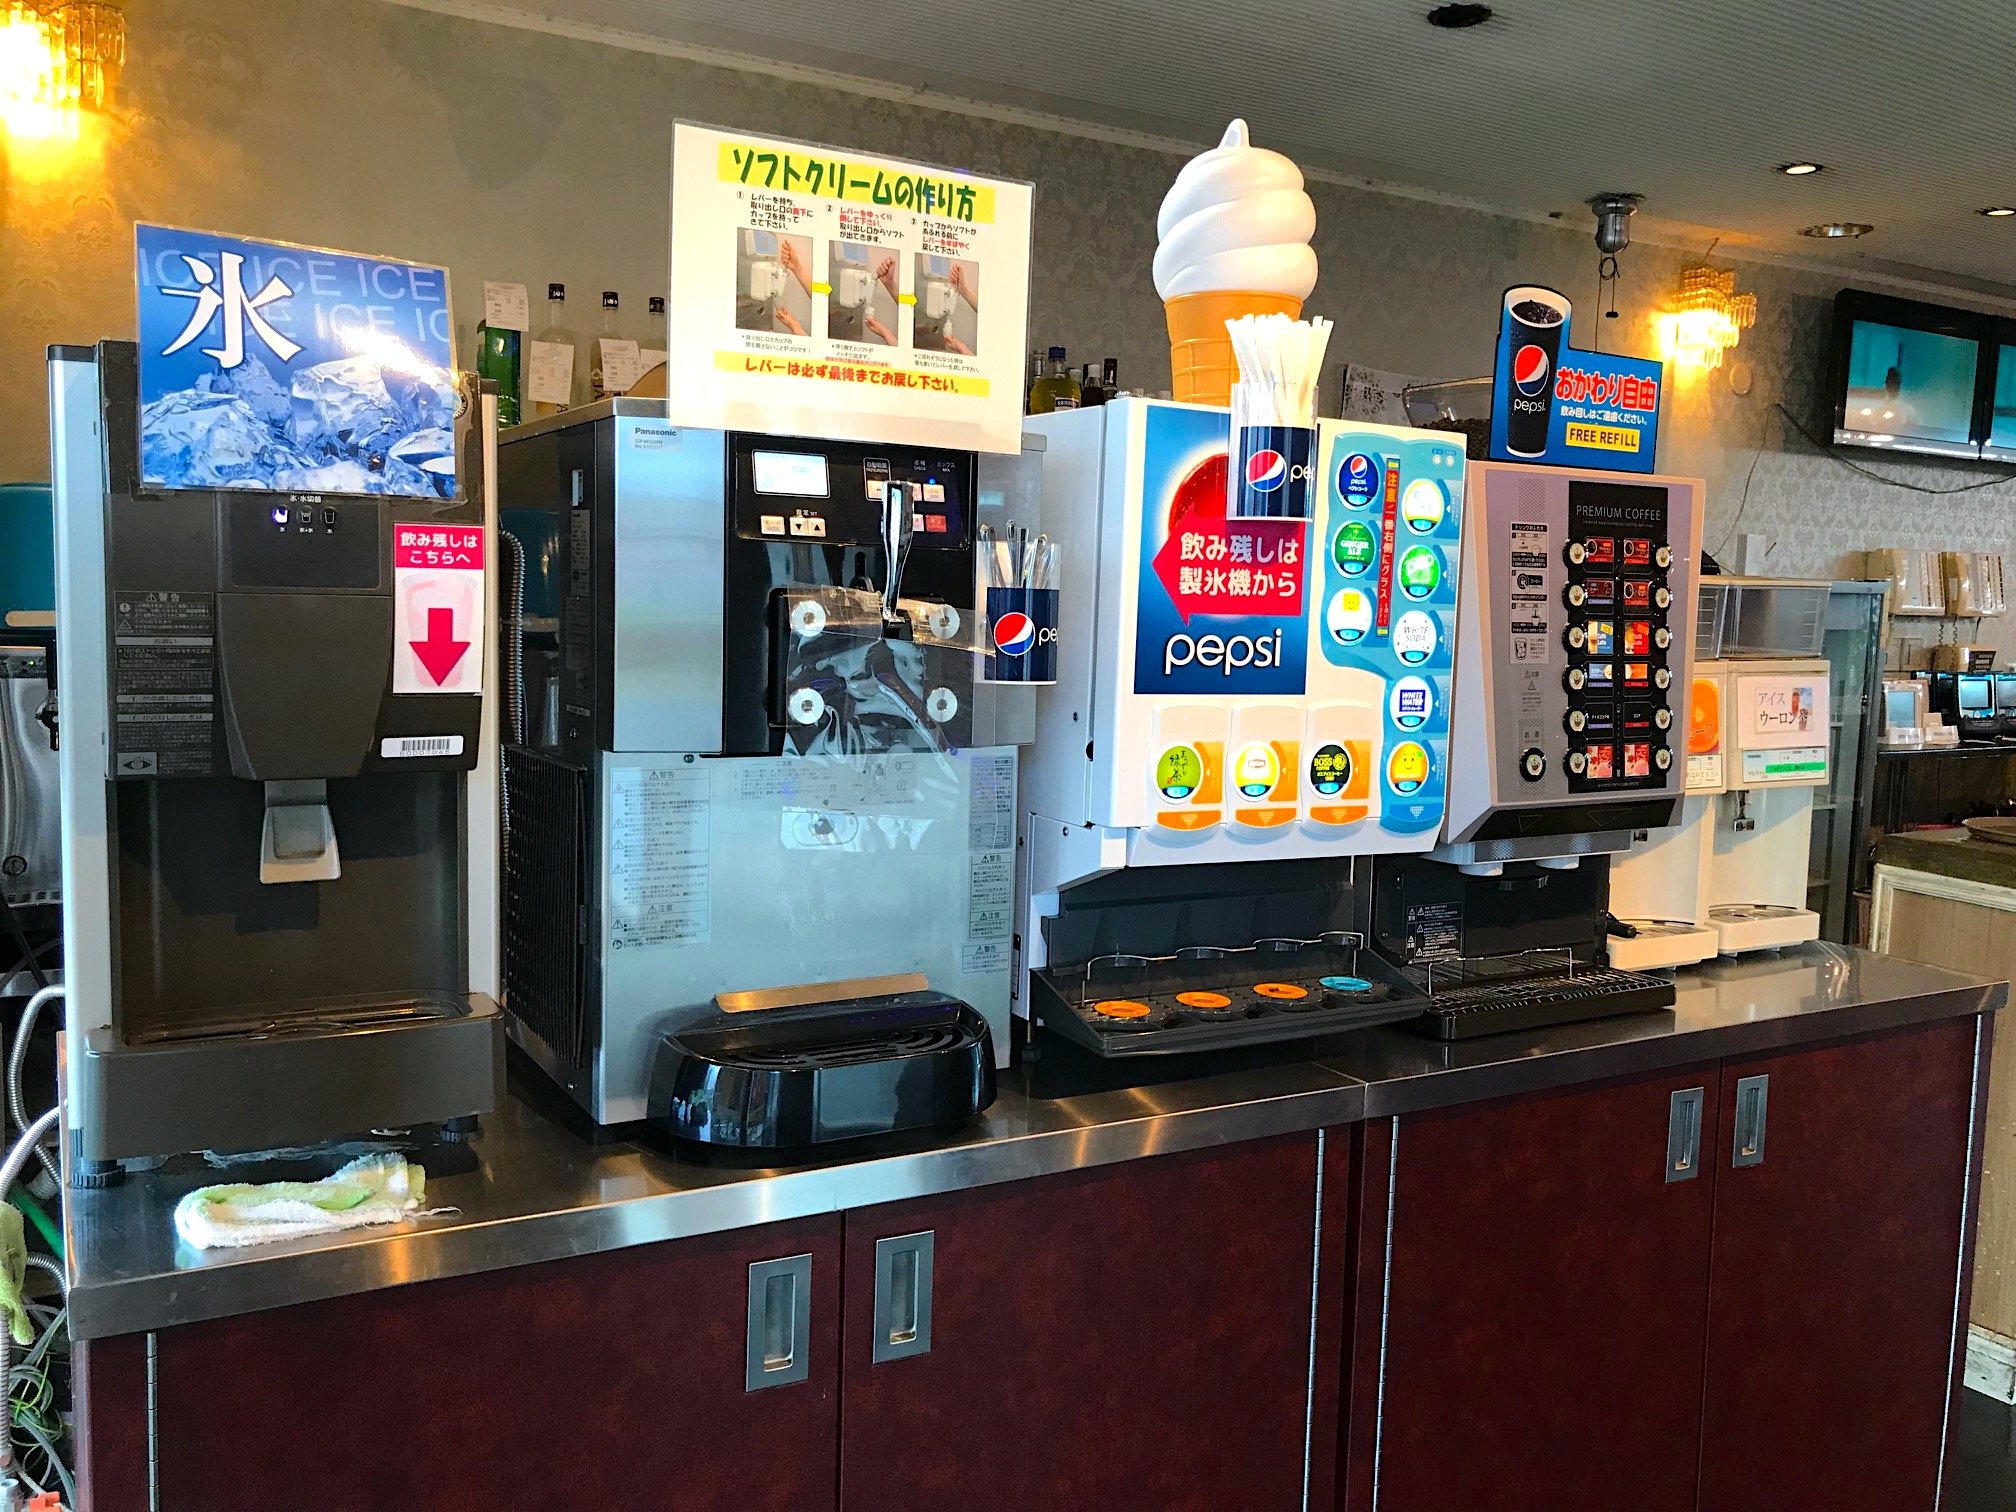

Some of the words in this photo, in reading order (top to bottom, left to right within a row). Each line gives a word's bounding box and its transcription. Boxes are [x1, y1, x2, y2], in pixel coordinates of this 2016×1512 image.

[732, 149, 977, 222] ソフトクリームの作り方
[357, 262, 441, 302] ICE
[159, 250, 306, 369] 氷
[745, 357, 960, 394] レバーは必ず最後までお戻し下さい。
[1555, 366, 1658, 413] おかわり自由
[1514, 398, 1546, 415] pepsi
[1560, 405, 1648, 426] 飲み回しはご遠慮ください。
[634, 427, 677, 437] Panasonic
[1569, 428, 1597, 443] FREE
[1600, 431, 1637, 447] REFILL
[1576, 504, 1623, 519] PREMIUM
[1625, 508, 1661, 521] COFFEE
[400, 531, 479, 549] 飲み残しは
[1180, 531, 1300, 565] 飲み残しは
[409, 550, 472, 565] こちらへ
[1179, 566, 1297, 597] 製氷機から
[1404, 626, 1429, 634] WHITE
[1405, 634, 1426, 642] SODA
[1165, 628, 1283, 676] pepsi
[1758, 692, 1786, 706] アイス
[1760, 708, 1809, 728] ウーロン茶
[1313, 757, 1333, 767] BOSS
